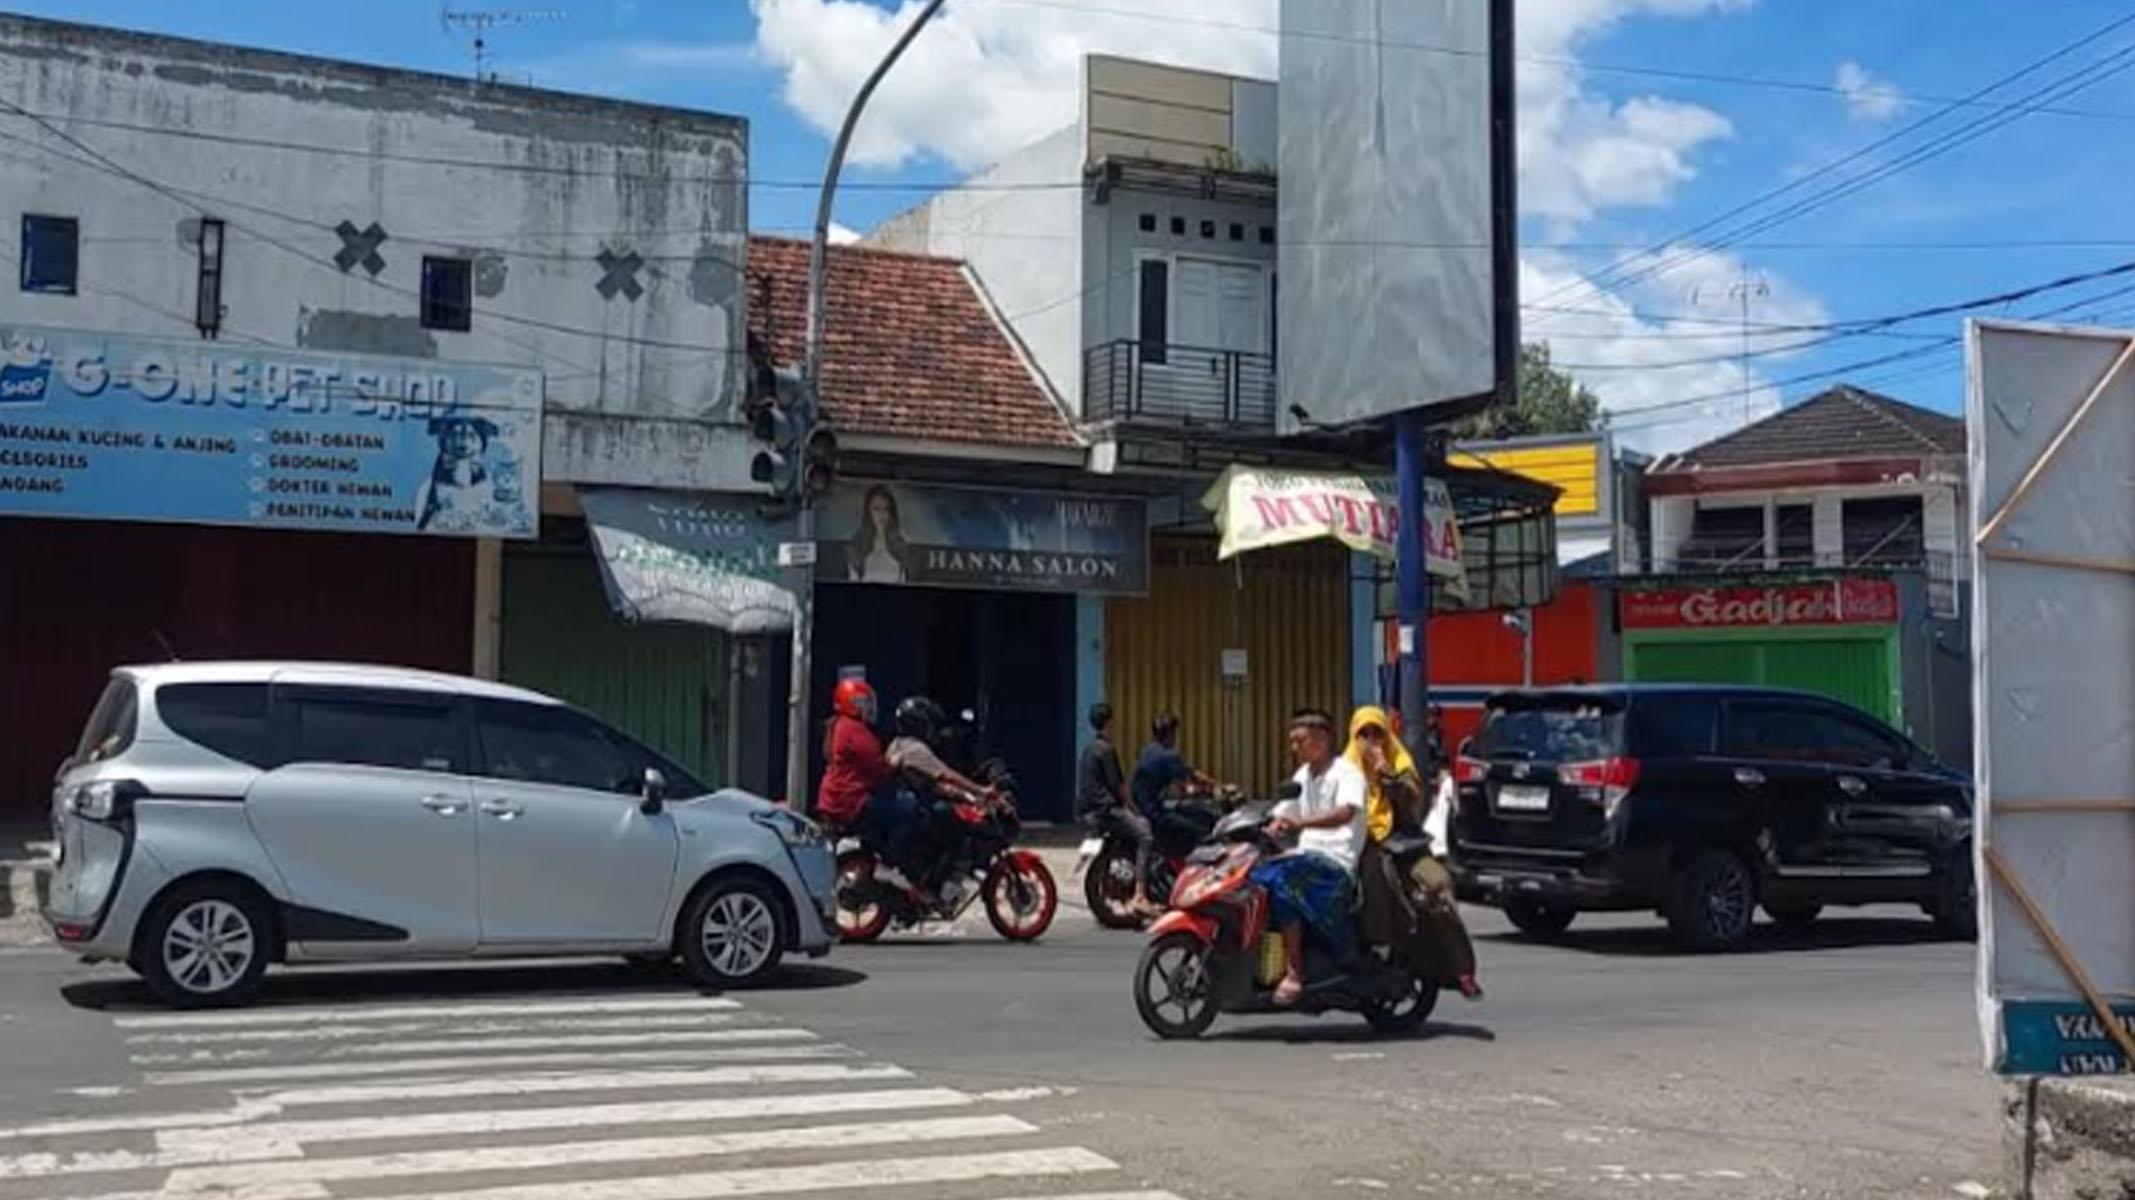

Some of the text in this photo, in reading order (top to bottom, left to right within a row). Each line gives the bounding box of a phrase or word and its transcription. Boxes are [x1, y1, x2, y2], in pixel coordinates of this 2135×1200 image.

[62, 348, 249, 408] G-ONE
[79, 428, 144, 447] KUCING
[153, 433, 165, 449] &
[174, 436, 236, 454] ANJING
[270, 429, 384, 449] OBAT-OBATAN
[268, 453, 359, 472] GROOMING
[268, 477, 392, 498] DOKTER HEWAN
[266, 501, 416, 523] PENITIPAN HEWAN
[928, 550, 1118, 578] HANNA SALON
